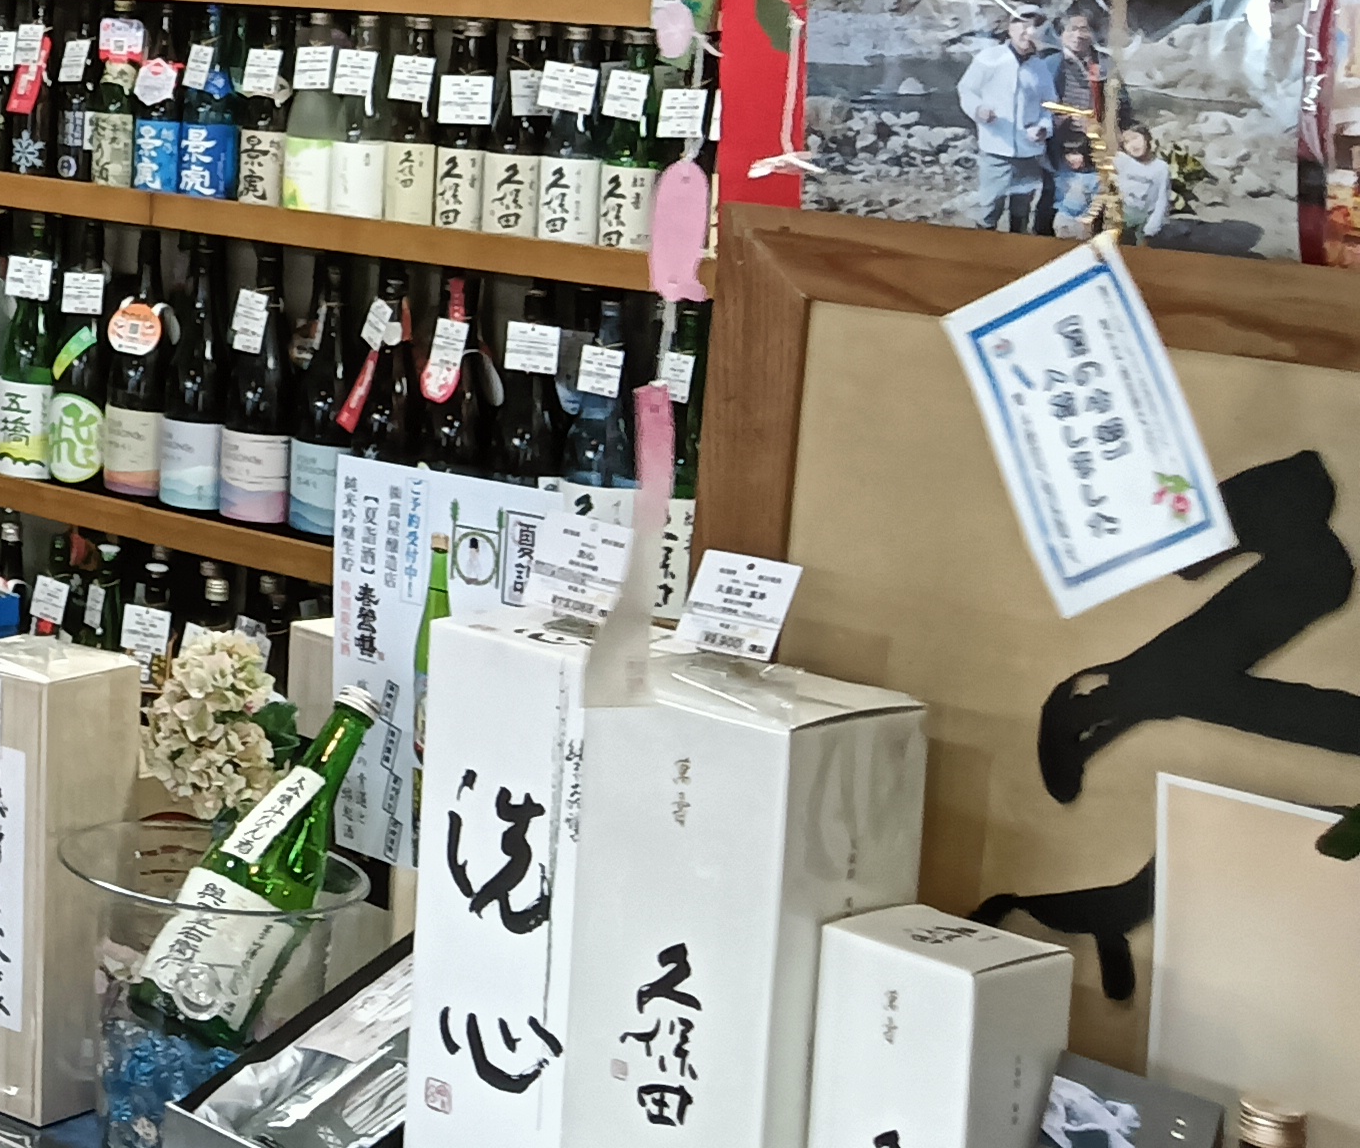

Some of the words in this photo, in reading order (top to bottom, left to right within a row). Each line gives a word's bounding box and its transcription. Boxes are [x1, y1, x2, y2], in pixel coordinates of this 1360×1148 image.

[440, 768, 563, 1095] 洗心
[619, 941, 704, 1129] 久保田
